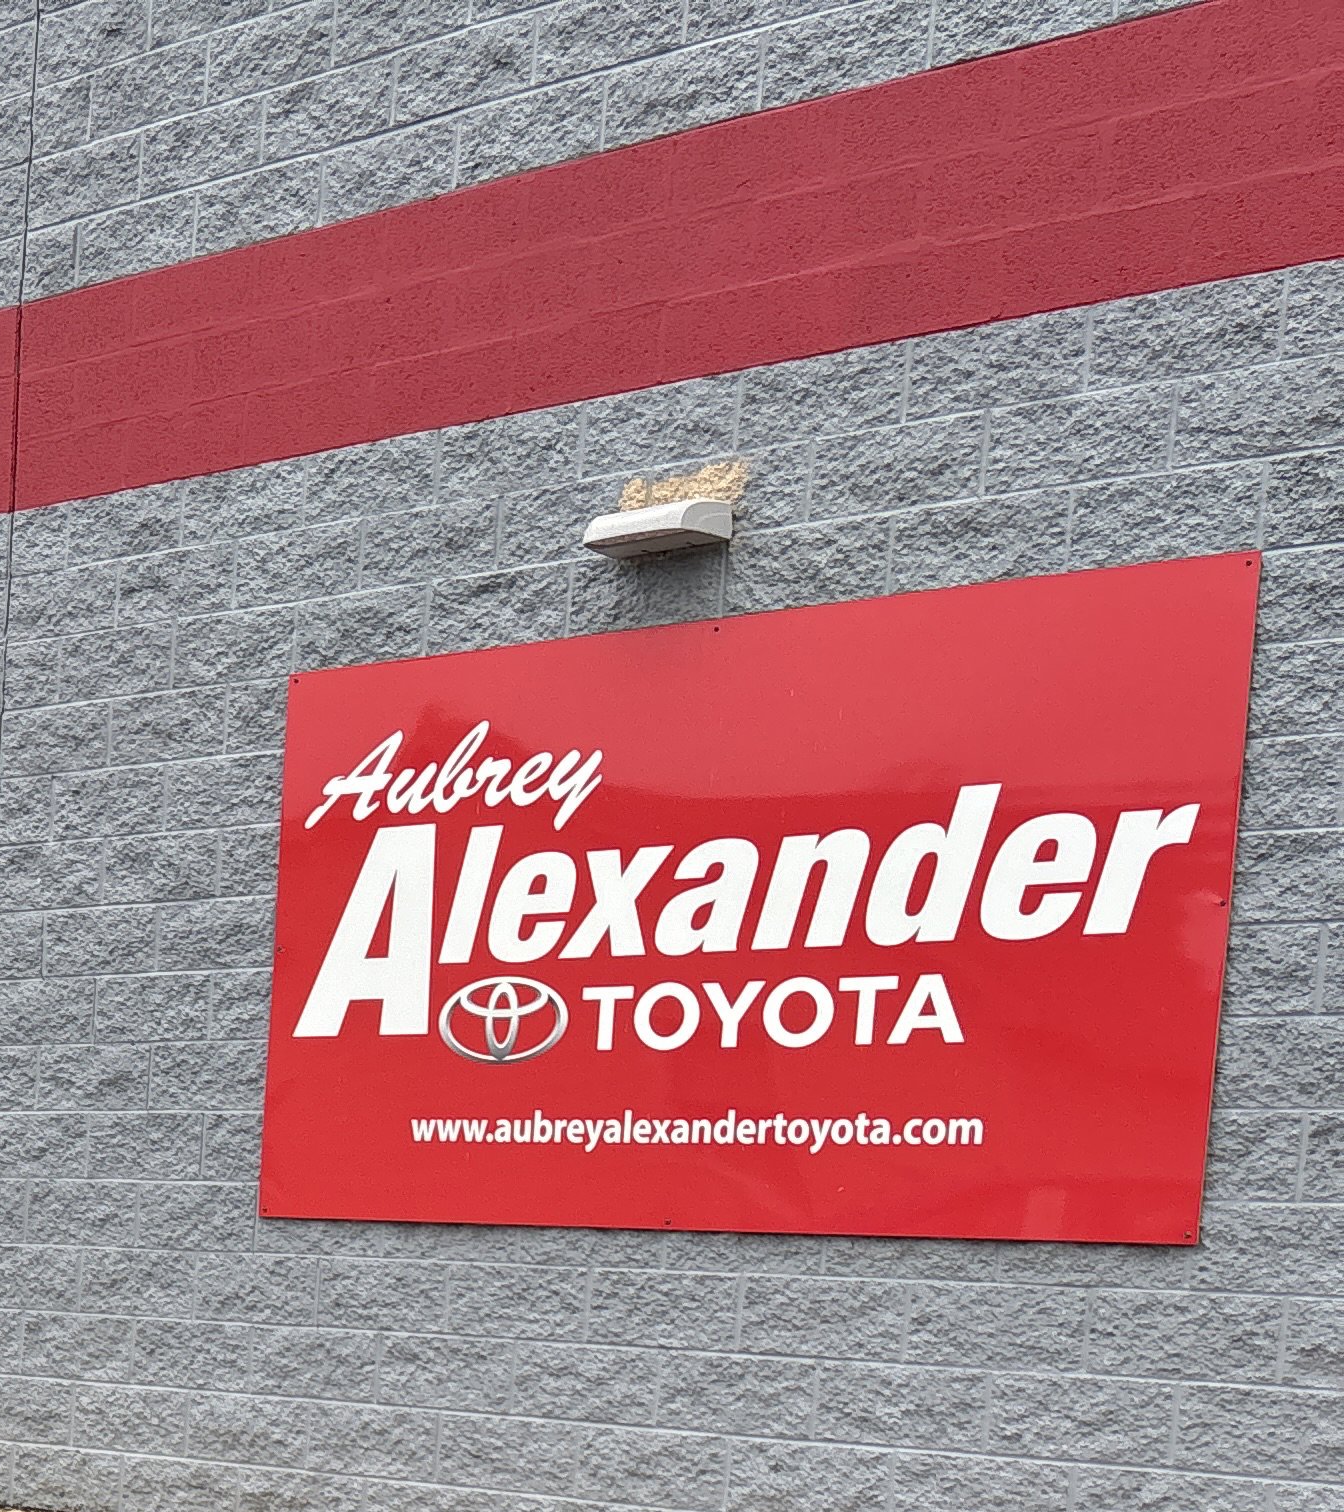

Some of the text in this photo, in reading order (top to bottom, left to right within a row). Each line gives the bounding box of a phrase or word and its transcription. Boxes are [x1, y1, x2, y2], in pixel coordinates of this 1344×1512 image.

[305, 720, 603, 831] Aubrey
[292, 783, 1201, 1038] Alexander
[582, 973, 965, 1051] TOYOTA
[410, 1109, 984, 1155] www.aubreyalexandertoyota.com
